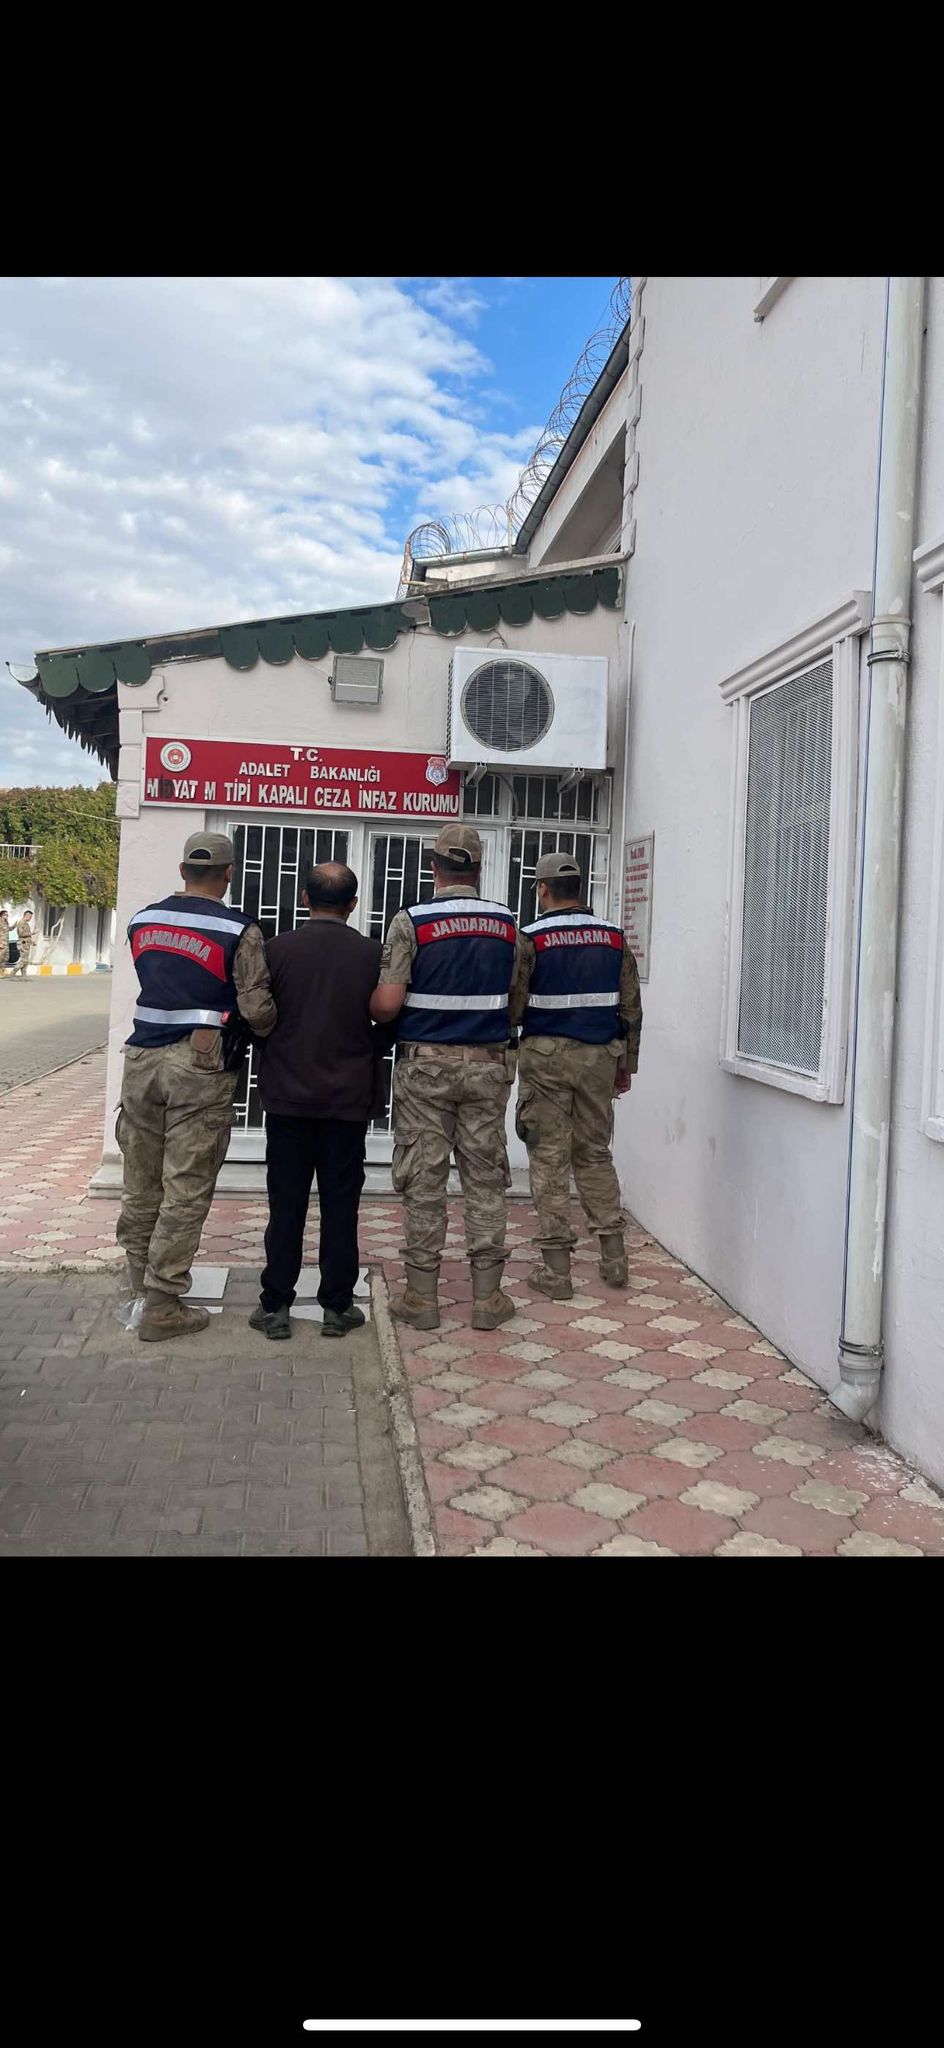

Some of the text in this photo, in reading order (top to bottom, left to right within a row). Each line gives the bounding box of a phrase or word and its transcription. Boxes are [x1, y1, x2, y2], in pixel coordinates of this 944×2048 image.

[290, 747, 323, 763] T.C.
[239, 762, 381, 783] ADALET BAKANLIĞI
[224, 779, 251, 803] TİPİ
[258, 784, 308, 806] KAPALI
[314, 787, 352, 808] CEZA
[358, 785, 397, 811] İNFAZ
[403, 792, 459, 813] KURUMU
[430, 917, 508, 938] JANDARMA
[138, 930, 212, 962] JANDARMA
[543, 930, 612, 948] JANDARMA
